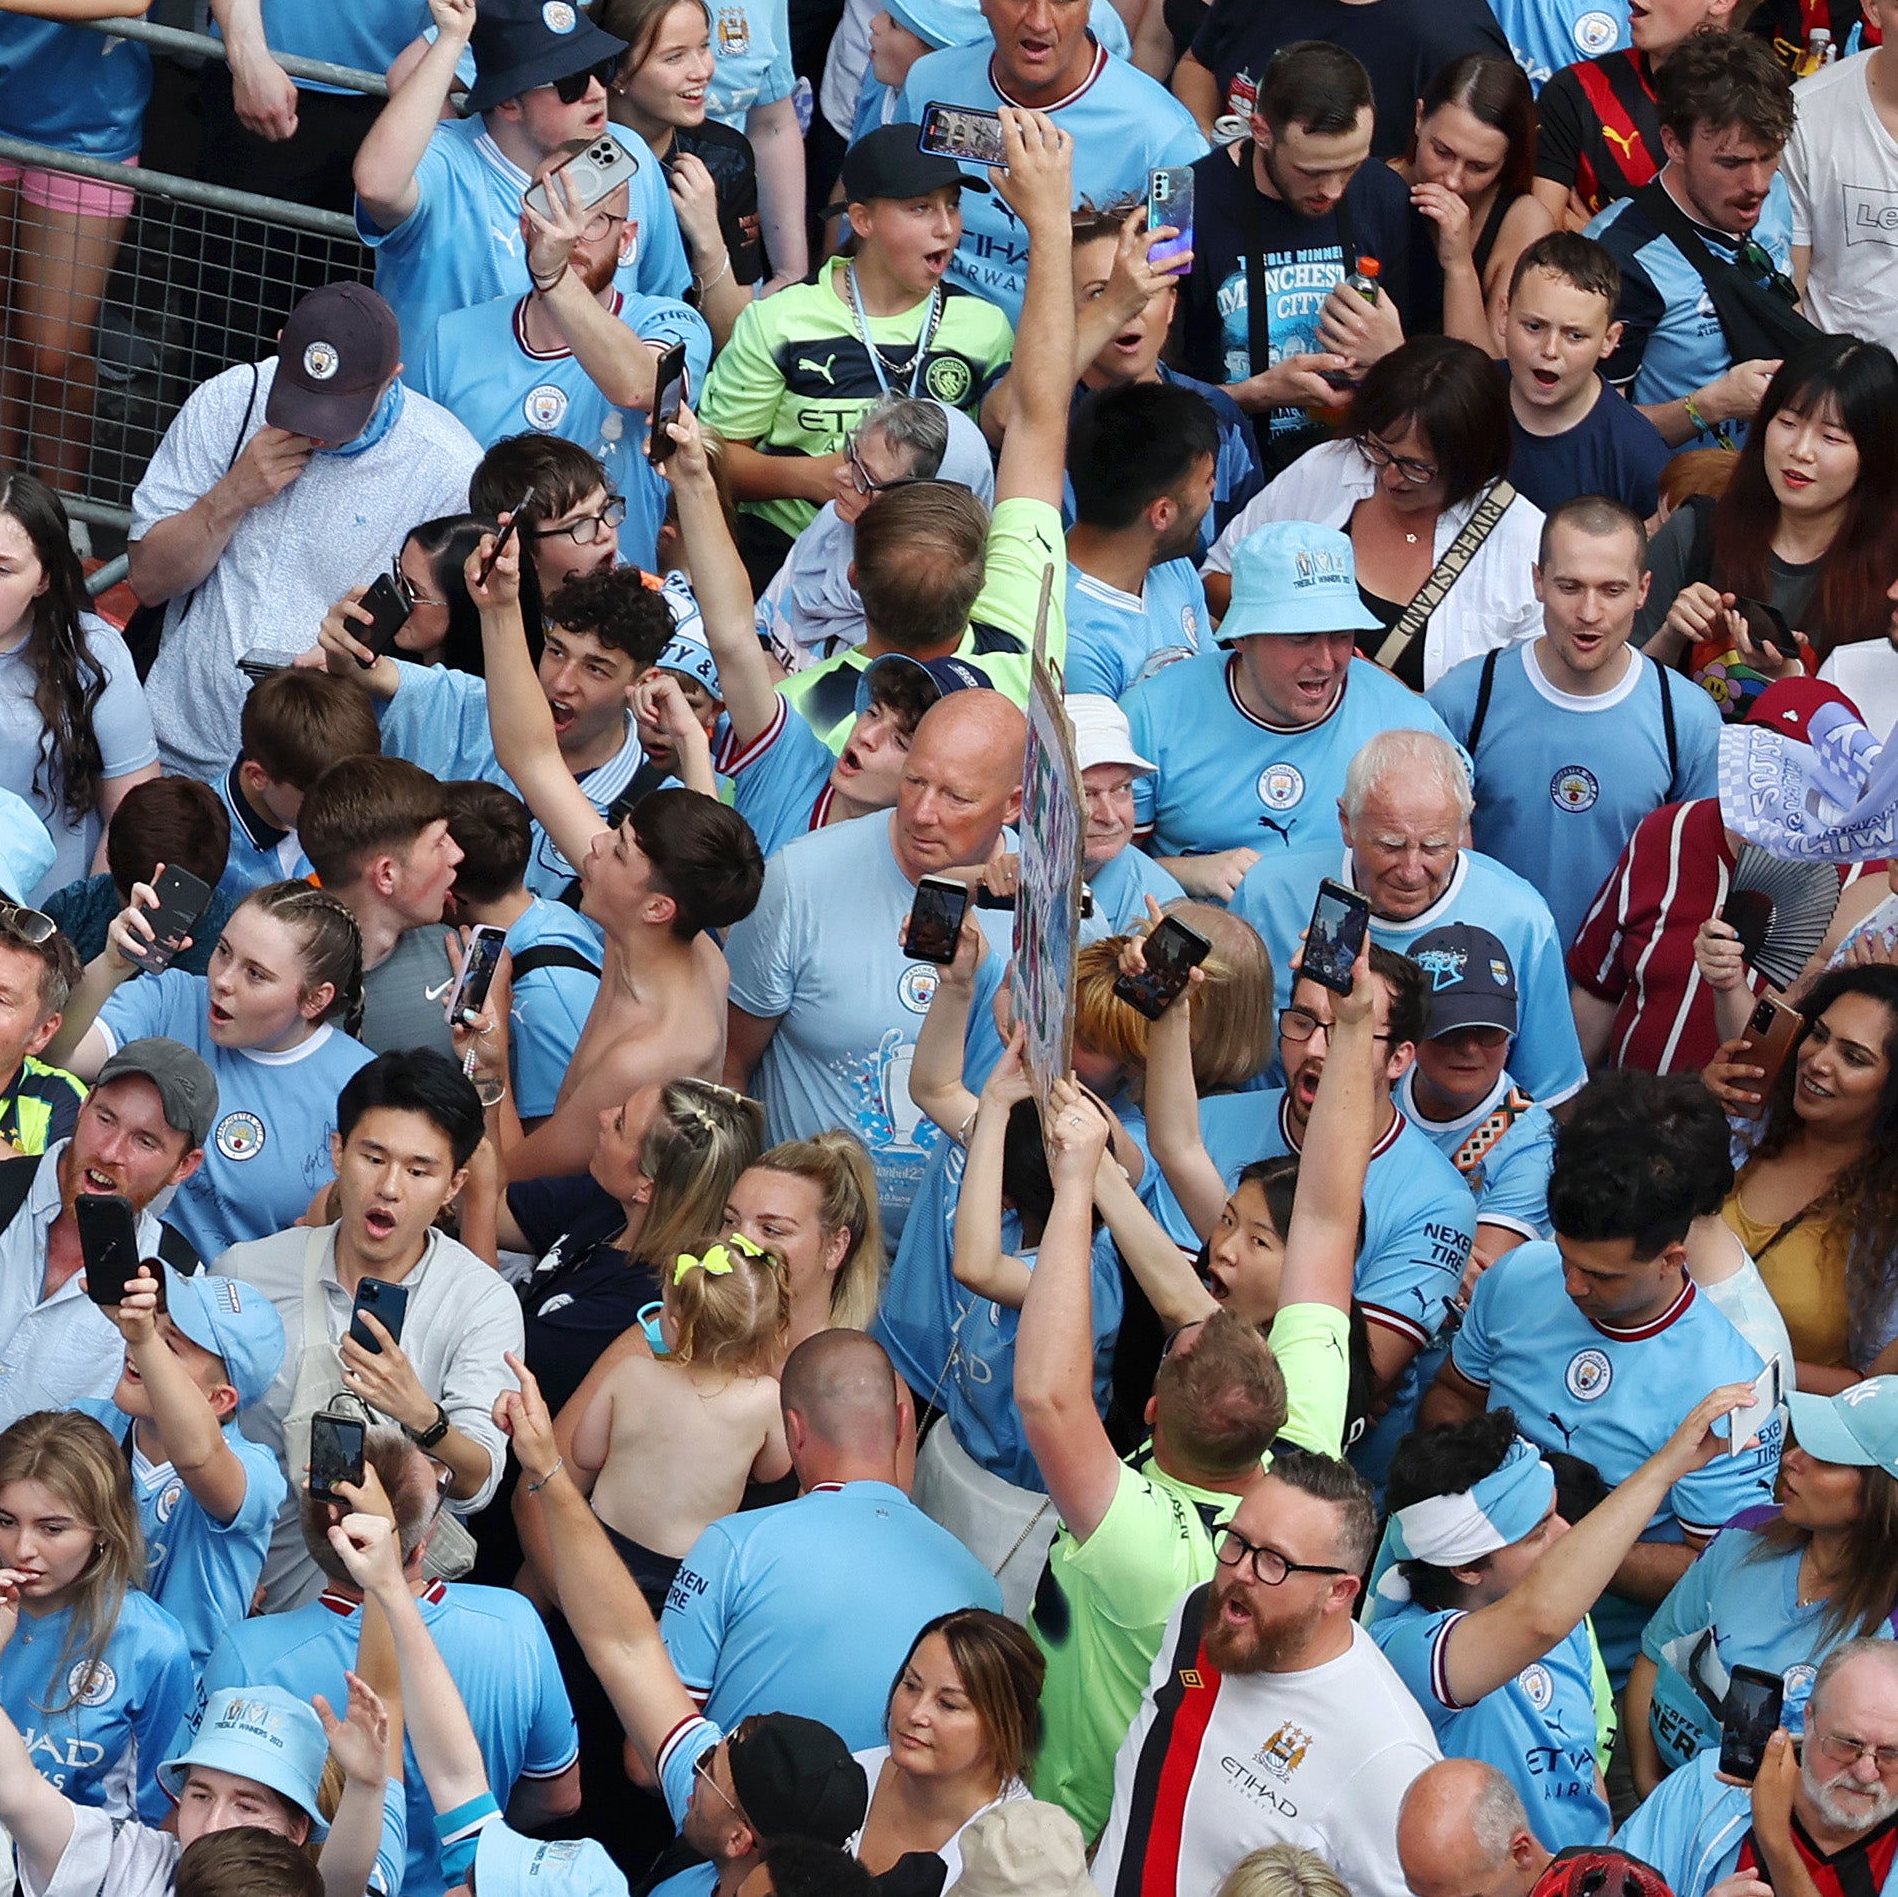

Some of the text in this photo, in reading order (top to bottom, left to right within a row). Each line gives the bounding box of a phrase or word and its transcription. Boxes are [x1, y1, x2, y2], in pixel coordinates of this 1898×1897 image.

[1400, 504, 1503, 633] RIVER ISLAND
[1430, 1243, 1462, 1273] TIRE
[1220, 1756, 1297, 1819] ETIHAD
